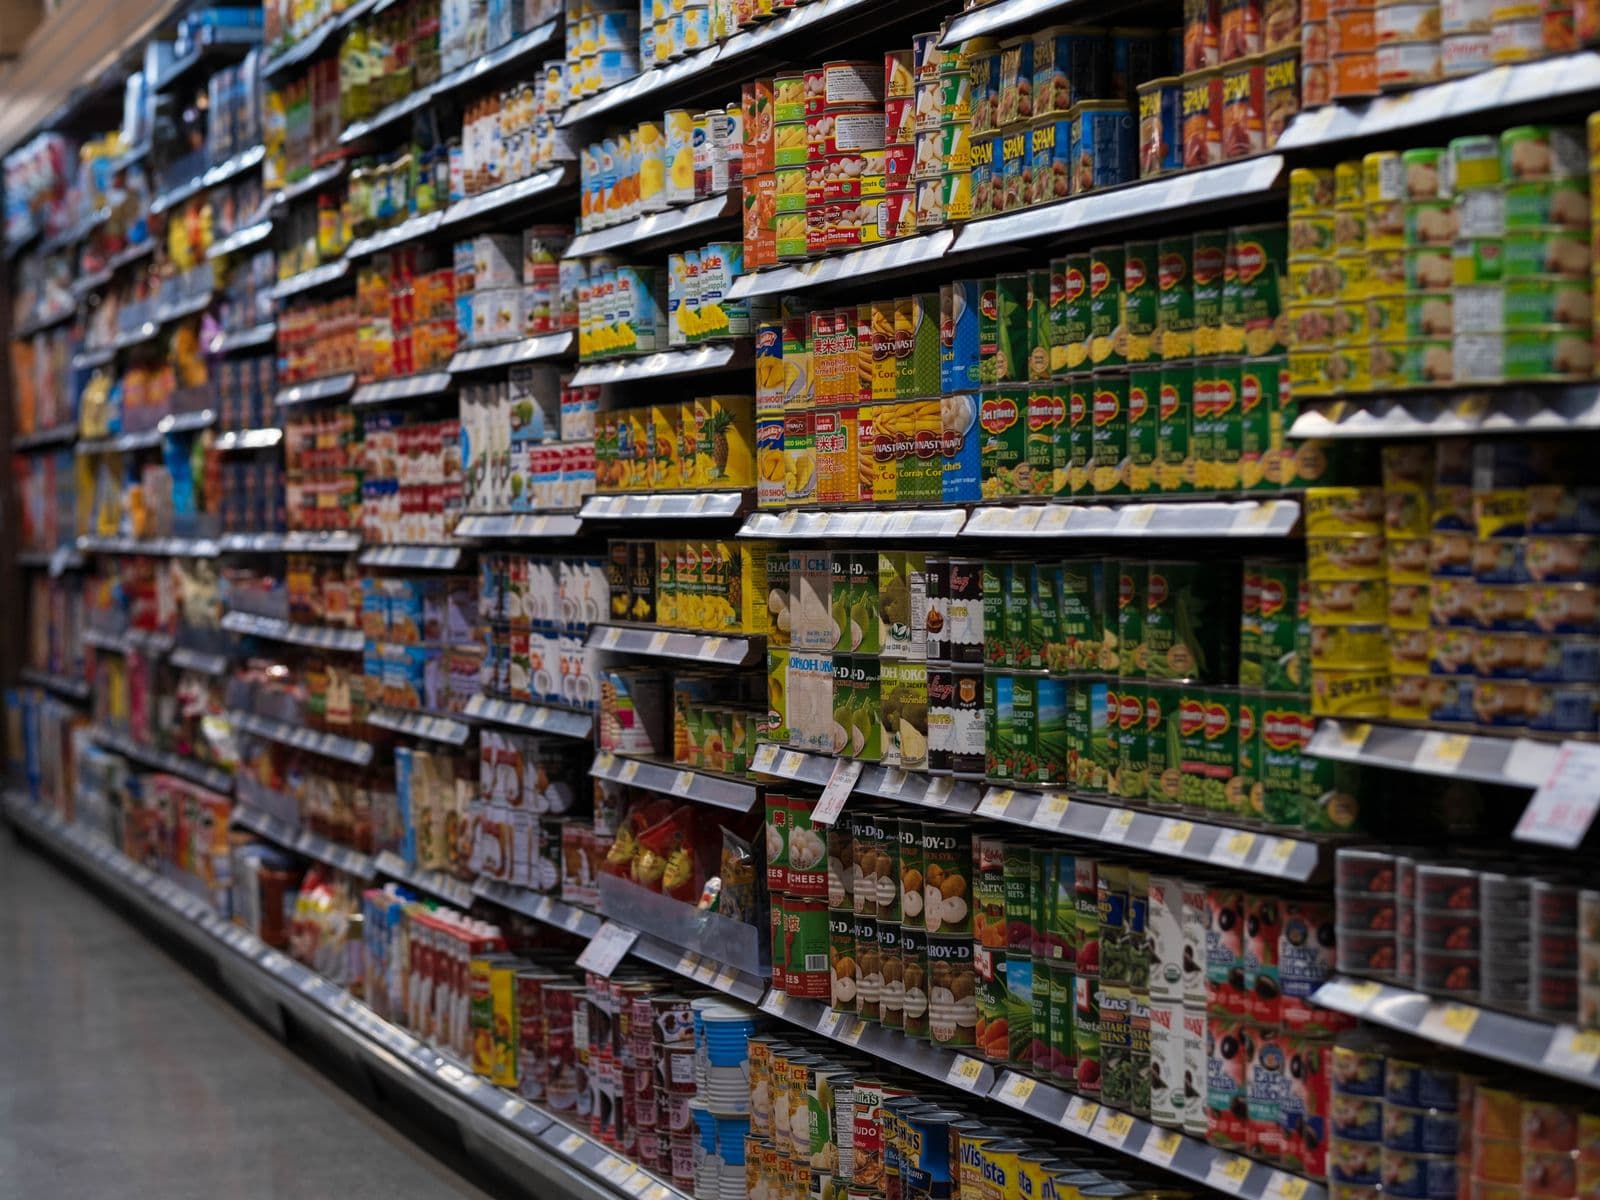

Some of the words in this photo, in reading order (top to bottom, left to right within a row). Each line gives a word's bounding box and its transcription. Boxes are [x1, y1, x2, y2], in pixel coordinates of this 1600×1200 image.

[1003, 136, 1024, 161] SPAM
[1033, 127, 1055, 152] SPAM
[970, 143, 993, 167] SPAM
